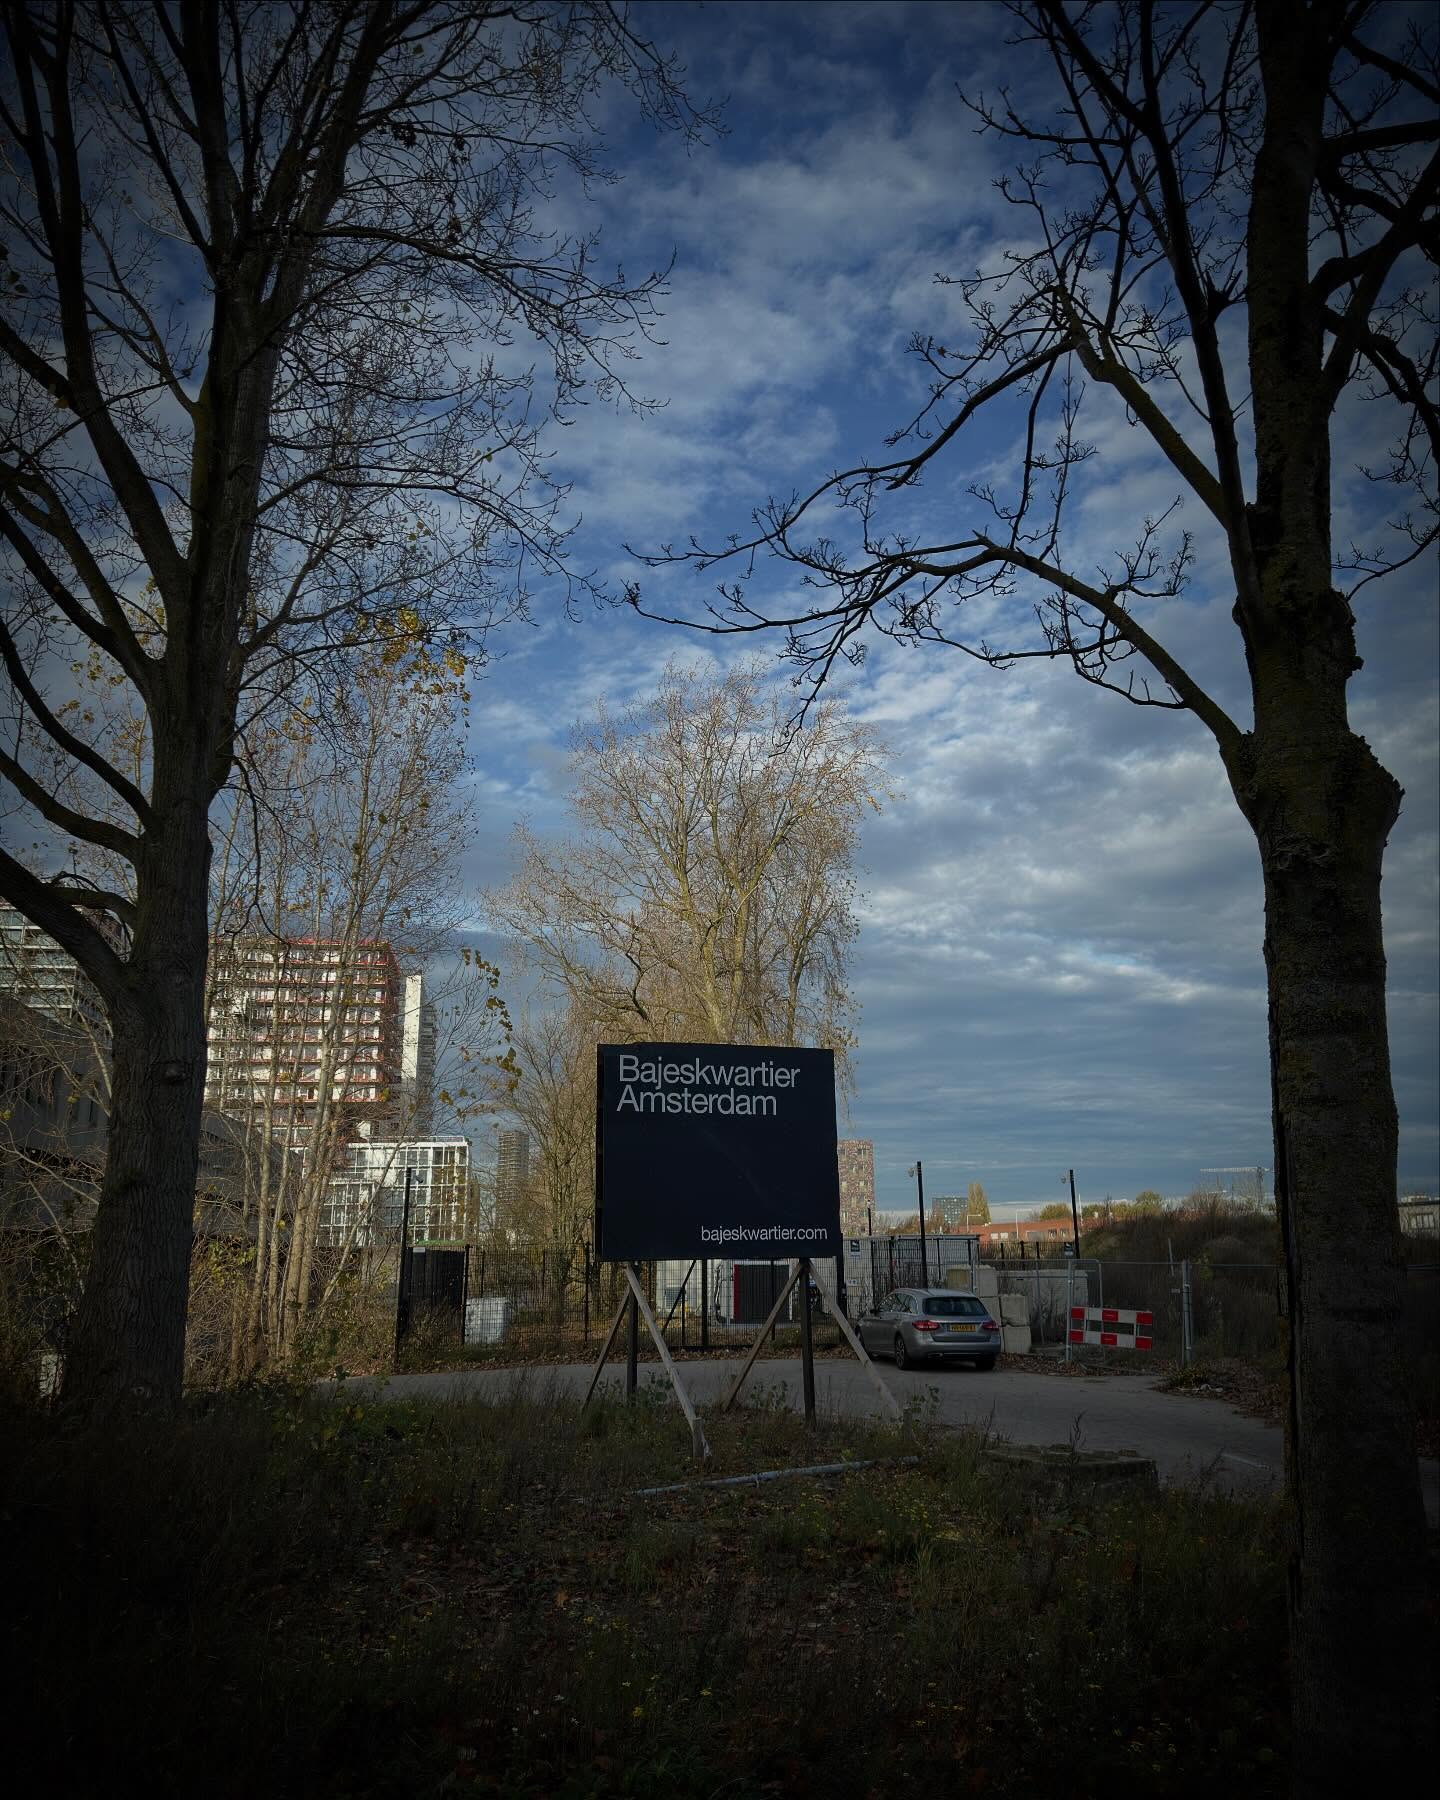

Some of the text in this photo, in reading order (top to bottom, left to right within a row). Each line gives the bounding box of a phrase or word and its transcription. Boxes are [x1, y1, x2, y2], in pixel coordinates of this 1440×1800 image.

[619, 1054, 800, 1090] Bajeskwartier
[616, 1084, 777, 1115] Amsterdam
[701, 1226, 828, 1245] bajeskwartier.com
